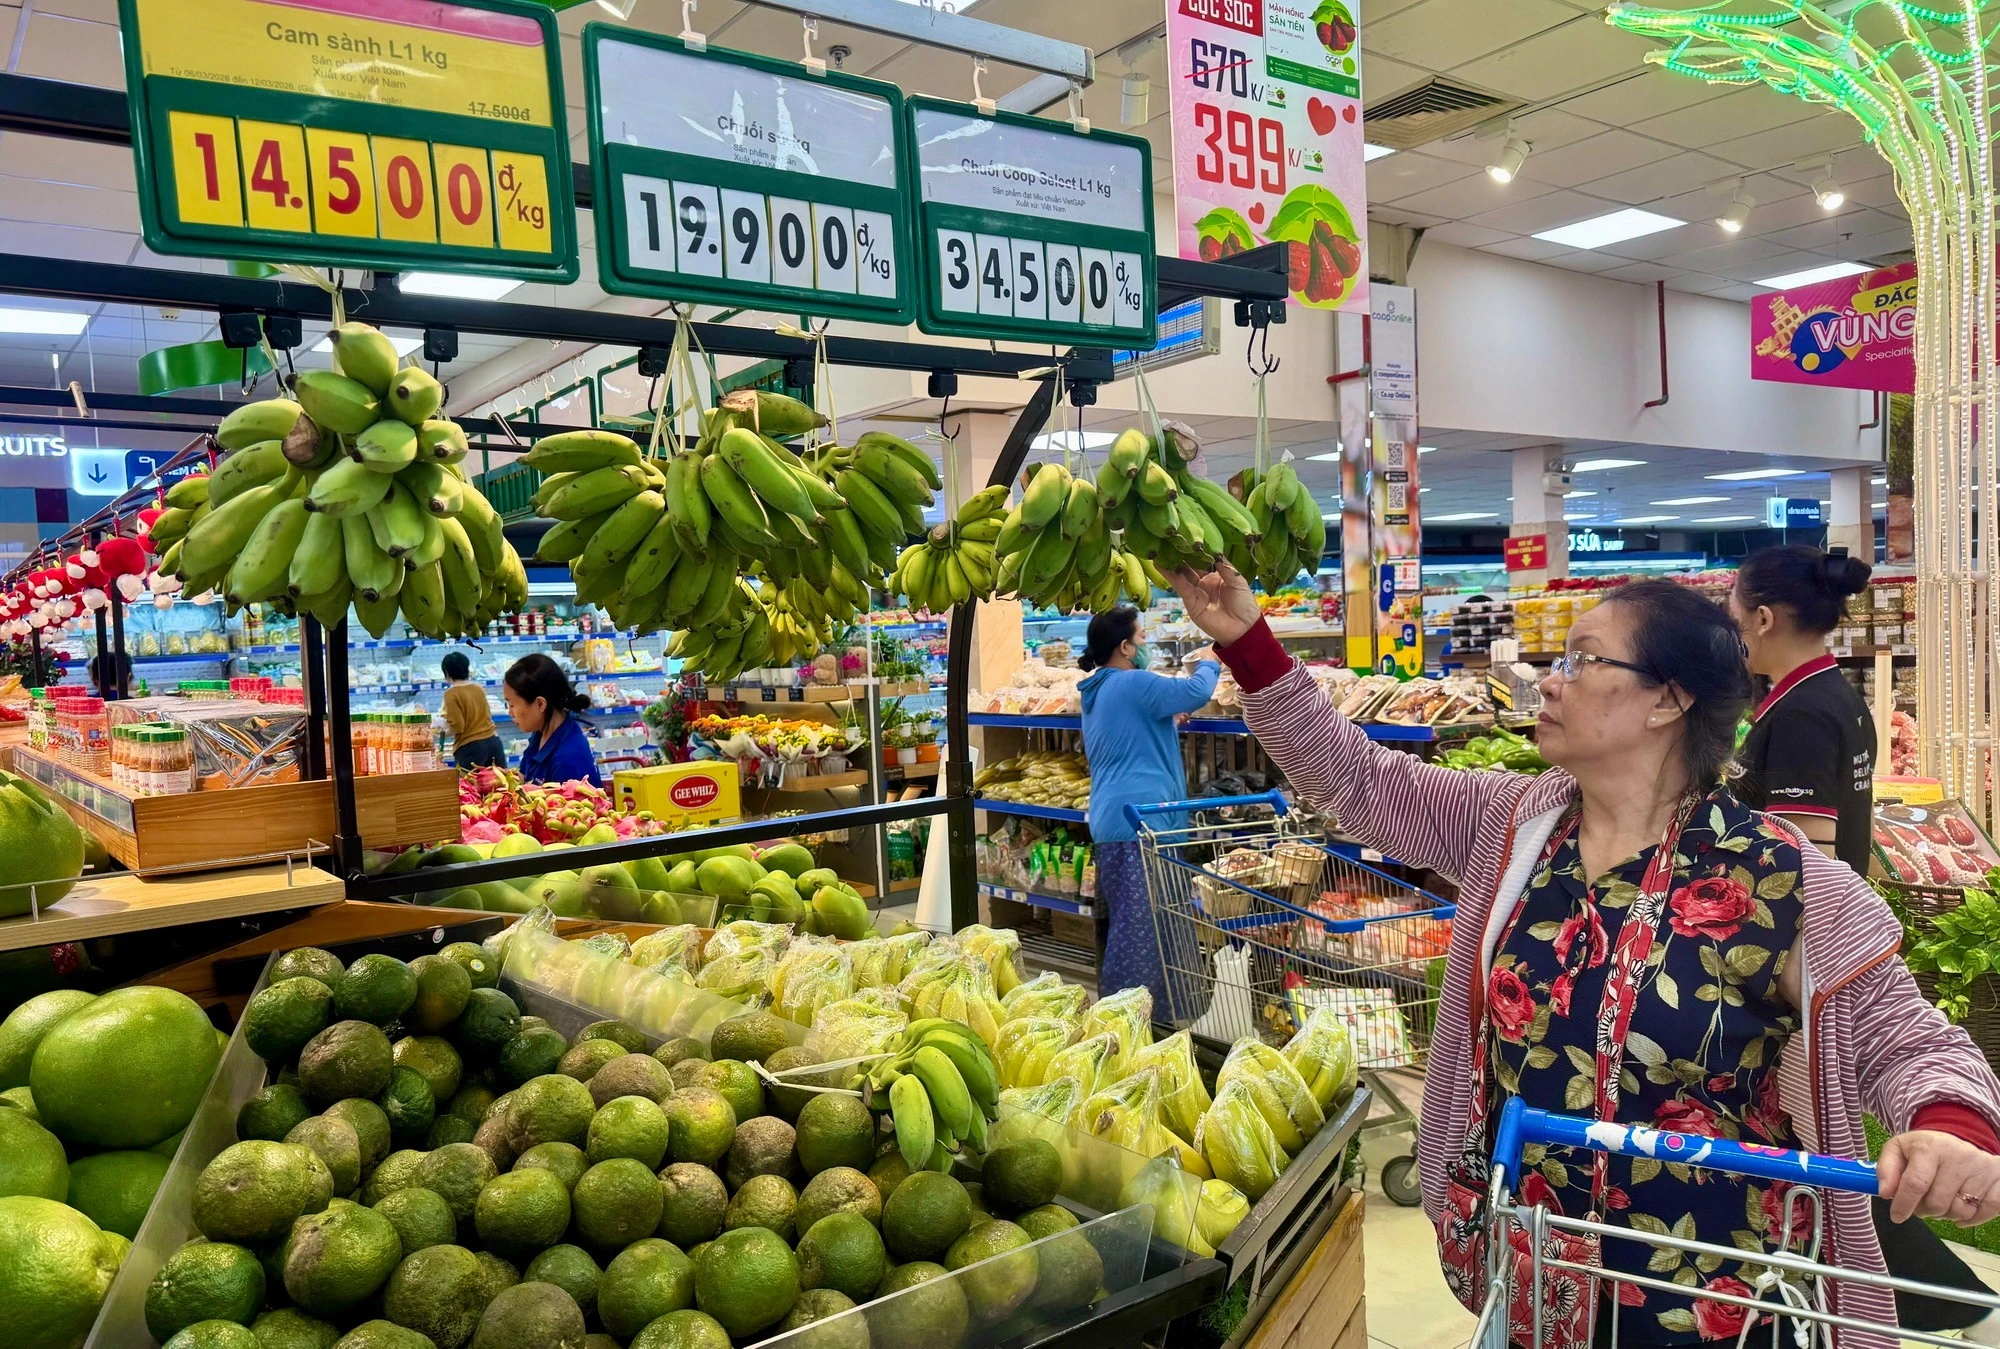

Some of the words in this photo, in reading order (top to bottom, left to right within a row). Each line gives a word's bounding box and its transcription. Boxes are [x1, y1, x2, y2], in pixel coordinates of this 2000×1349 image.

[266, 21, 319, 46] Cam
[327, 32, 382, 56] sành
[389, 40, 414, 61] L1
[422, 45, 448, 69] kg
[1288, 20, 1305, 32] TIÊN
[311, 54, 333, 66] Sản
[367, 65, 381, 74] an
[313, 68, 338, 80] Xuất
[360, 74, 379, 85] Việt
[382, 78, 407, 89] Nam
[1191, 38, 1247, 99] 670
[468, 101, 531, 121] 17.500đ
[1194, 102, 1287, 196] 399
[194, 132, 484, 226] 14.500
[498, 163, 545, 230] đ/kg
[961, 158, 999, 178] Chuối
[1002, 168, 1036, 186] Coop
[1039, 171, 1077, 190] Select
[1079, 178, 1093, 193] L1
[1096, 181, 1111, 197] kg
[1052, 204, 1067, 213] Nam
[640, 191, 848, 270] 19.900
[856, 222, 890, 279] đ/kg
[947, 238, 1108, 310] 34.500
[1115, 260, 1141, 311] đ/kg
[1812, 307, 1916, 352] VÙNG
[674, 788, 691, 800] GEE
[692, 784, 716, 797] WHIZ
